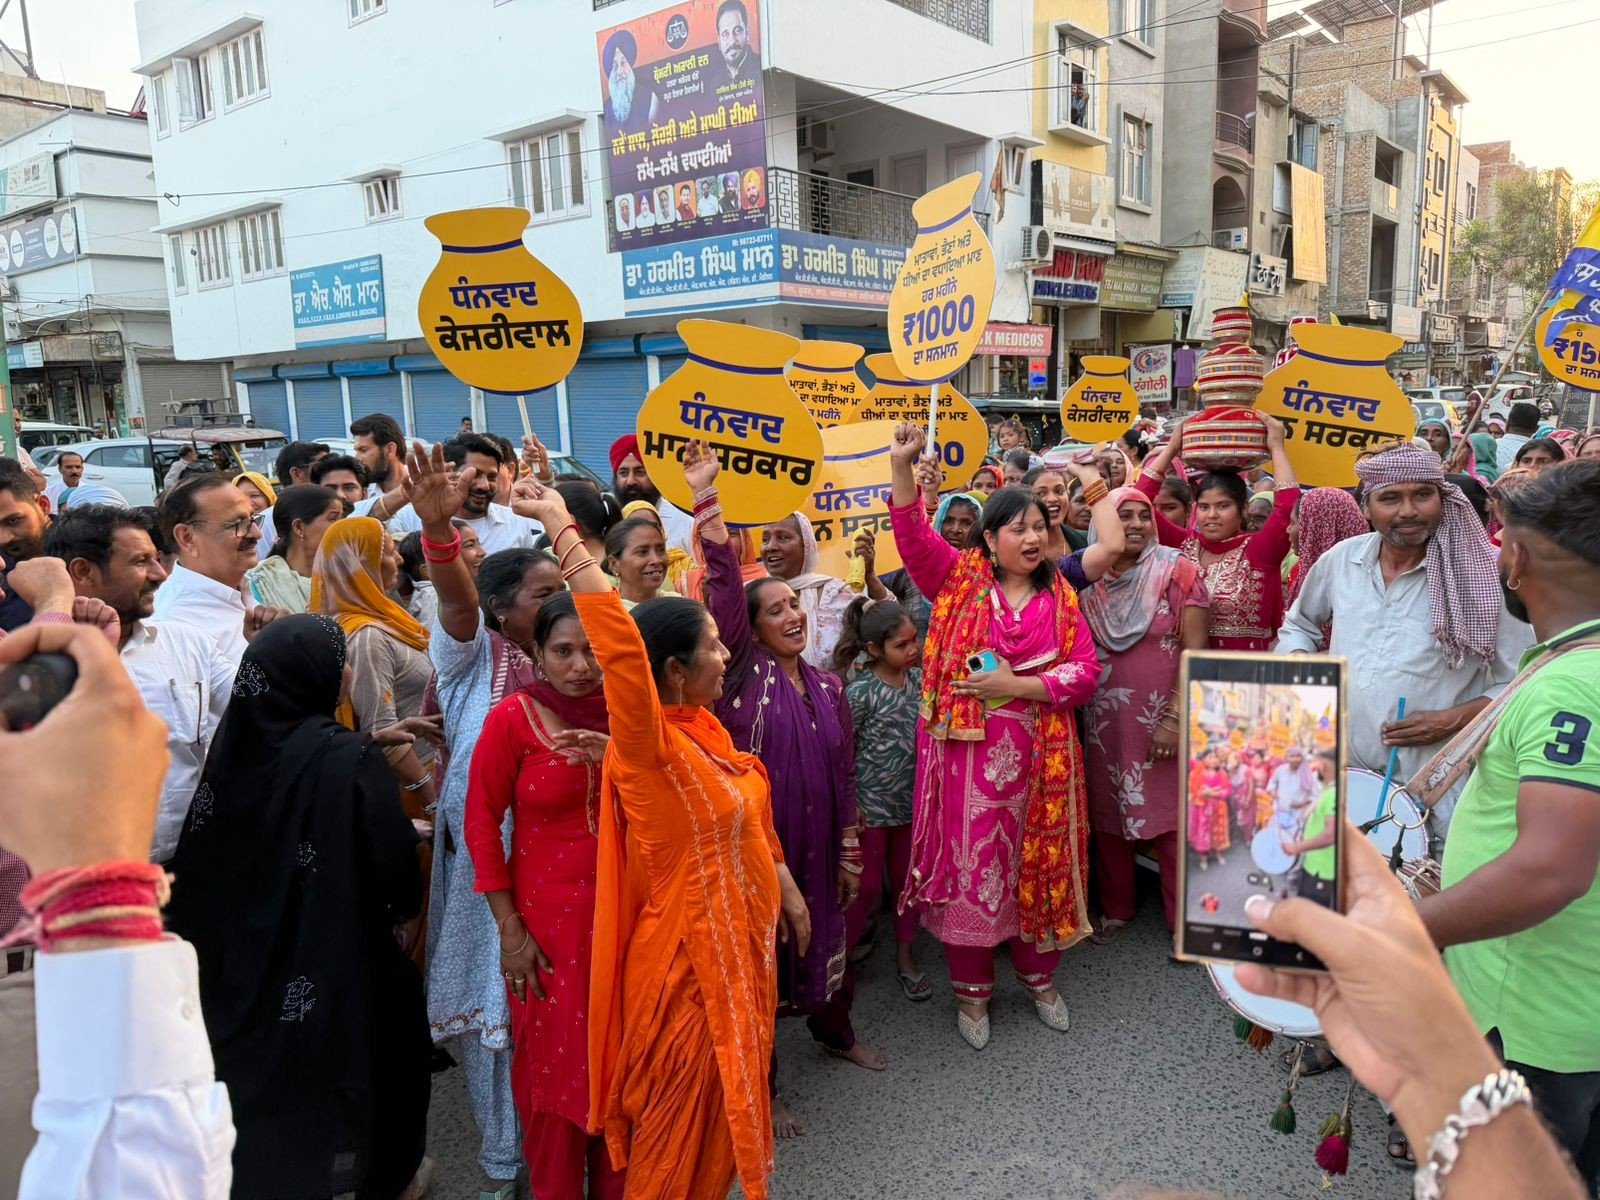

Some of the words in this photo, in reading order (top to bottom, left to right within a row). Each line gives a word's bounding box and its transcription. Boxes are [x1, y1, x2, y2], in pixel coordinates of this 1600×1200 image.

[679, 111, 698, 138] ਅਤੇ
[914, 243, 940, 267] ਮਾਤਾਵਾਂ,
[940, 236, 956, 257] ਭੈਣਾਂ
[957, 229, 972, 250] ਅਤੇ
[646, 251, 696, 283] ਹਰਮੀਤ
[700, 245, 737, 277] ਸਿੰਘ
[741, 244, 774, 271] ਮਾਨ
[803, 244, 847, 275] ਹਰਮੀਤ
[851, 247, 879, 279] ਸਿੰਘ
[921, 268, 931, 281] ਦਾ
[931, 254, 966, 279] ਵਧਾਇਆ
[966, 248, 983, 266] ਮਾਣ
[356, 280, 380, 305] ਮਾਨ
[448, 276, 538, 310] ਧੰਨਵਾਦ
[921, 289, 934, 303] ਹਰ
[935, 278, 958, 299] ਮਹੀਨੇ
[434, 312, 571, 352] ਕੇਜਰੀਵਾਲ
[902, 294, 975, 347] ₹1000
[995, 332, 1044, 347] MEDICOS
[1397, 342, 1425, 354] NEJA
[1553, 337, 1600, 364] ₹15
[913, 349, 923, 366] ਦਾ
[925, 341, 959, 363] ਸਨਮਾਨ
[1134, 375, 1168, 392] रंगोली
[1565, 364, 1578, 375] ਦਾ
[1580, 367, 1600, 379] ਸਨ
[789, 379, 819, 392] ਮਾਤਾਵਾਂ,
[821, 380, 838, 393] ਭੈਣਾਂ
[839, 382, 856, 394] ਅਤੇ
[1081, 386, 1122, 403] ਧੰਨਵਾਦ
[811, 395, 849, 406] ਵਧਾਇਆ
[851, 397, 861, 406] ਮਾ
[875, 395, 910, 408] ਮਾਤਾਵਾਂ,
[1282, 379, 1381, 422] ਧੰਨਵਾਦ
[679, 391, 785, 444] ਧੰਨਵਾਦ
[816, 409, 842, 420] ਮਹੀਨੇ
[861, 408, 887, 421] ਧੀਆਂ
[889, 411, 899, 421] ਦਾ
[949, 411, 968, 421] ਮਾਣ
[1067, 404, 1131, 423] ਕੇਜਰੀਵਾਲ
[1543, 711, 1593, 766] 3
